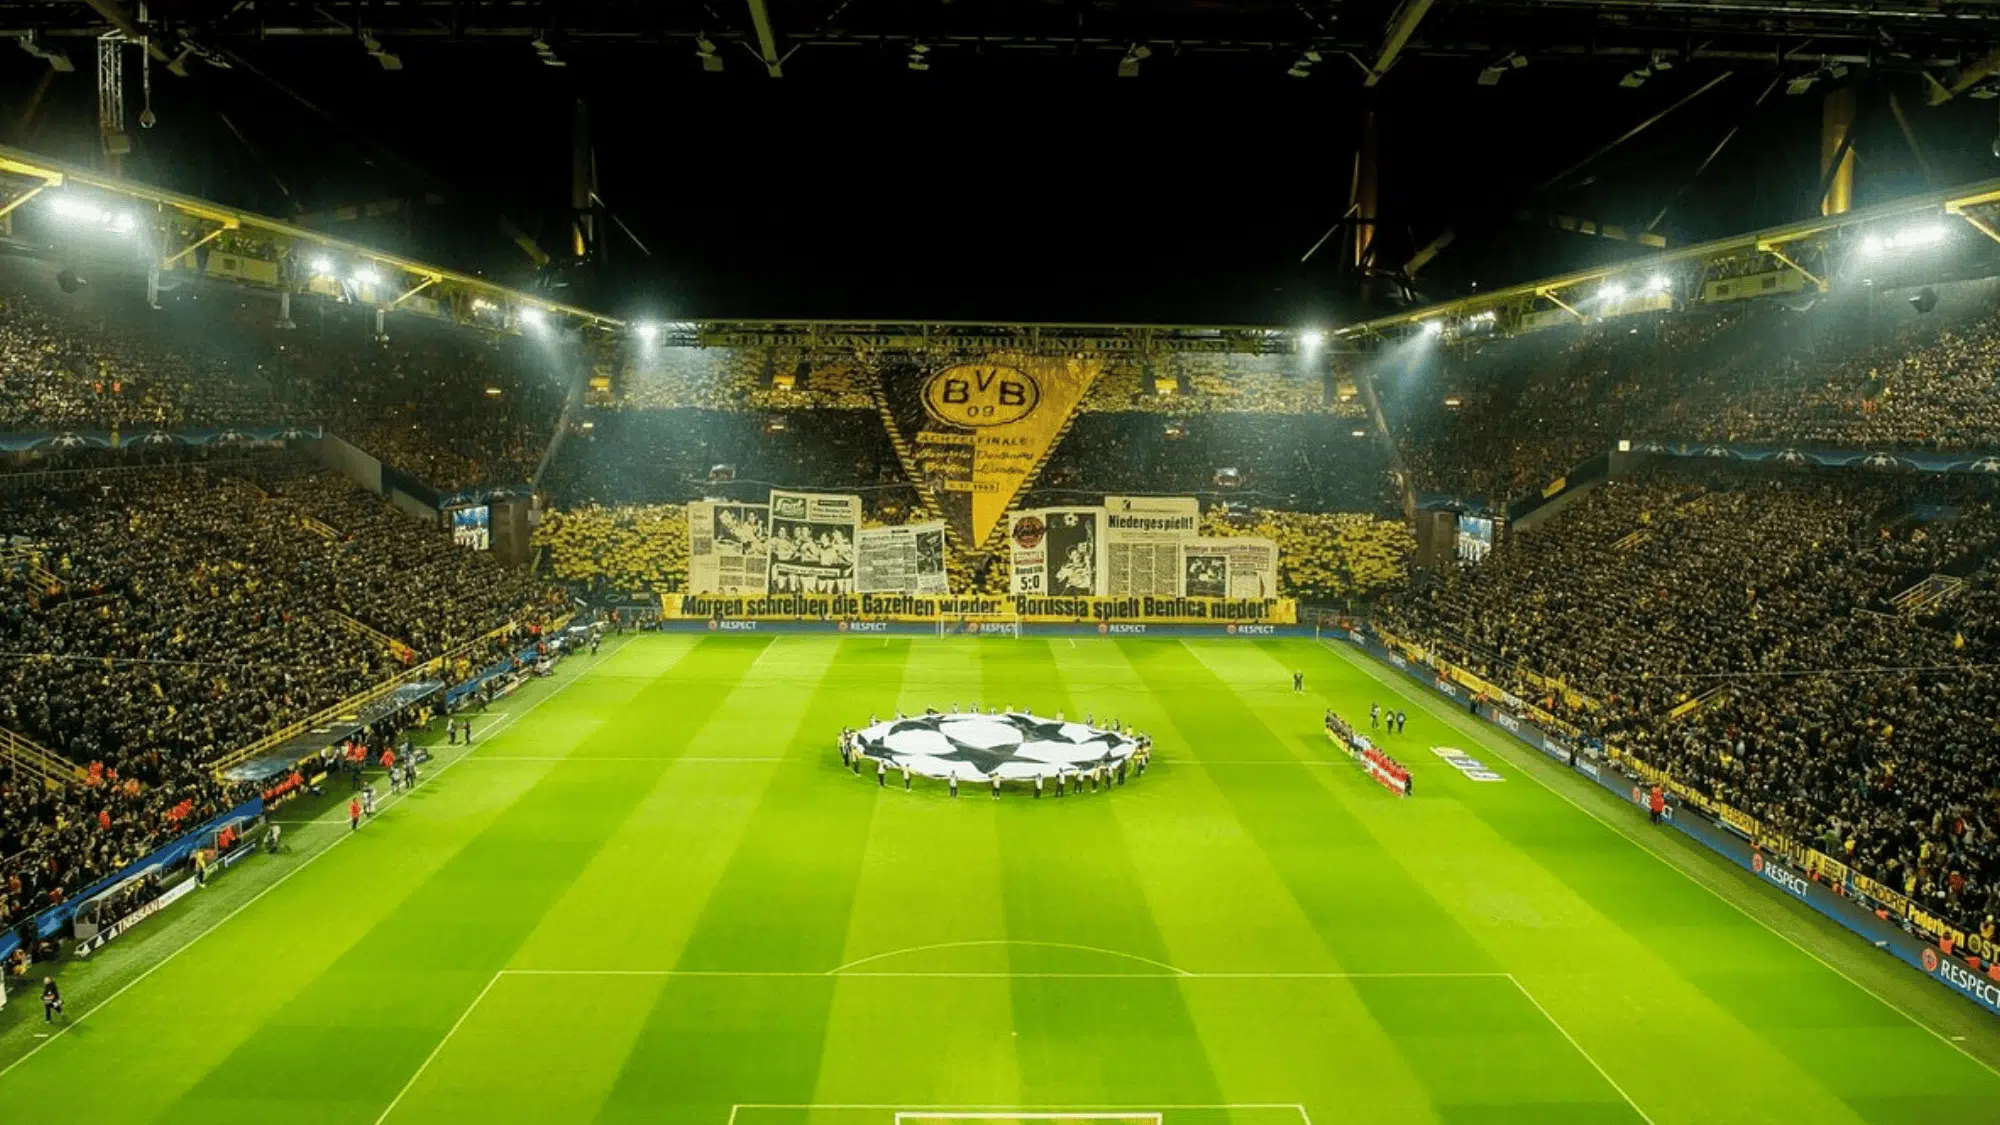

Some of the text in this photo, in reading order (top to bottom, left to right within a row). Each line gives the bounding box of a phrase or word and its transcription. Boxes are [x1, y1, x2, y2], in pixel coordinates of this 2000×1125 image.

[943, 369, 1026, 406] BVB
[967, 405, 995, 418] 09
[1108, 515, 1194, 531] Niedergespielt!
[1020, 575, 1040, 590] 5:0
[681, 595, 744, 618] Morgen
[746, 594, 828, 616] schreiben
[832, 595, 859, 615] die
[862, 592, 935, 616] Gazetten
[940, 597, 1001, 614] wieder:
[1093, 597, 1140, 621] spielt
[1144, 596, 1207, 617] Benfica
[720, 621, 757, 630] RESPECT
[850, 622, 887, 631] RESPECT
[1109, 624, 1146, 634] RESPECT
[1238, 626, 1275, 635] RESPECT
[1764, 860, 1809, 898] RESPECT
[1940, 958, 2000, 1009] RESPECT
